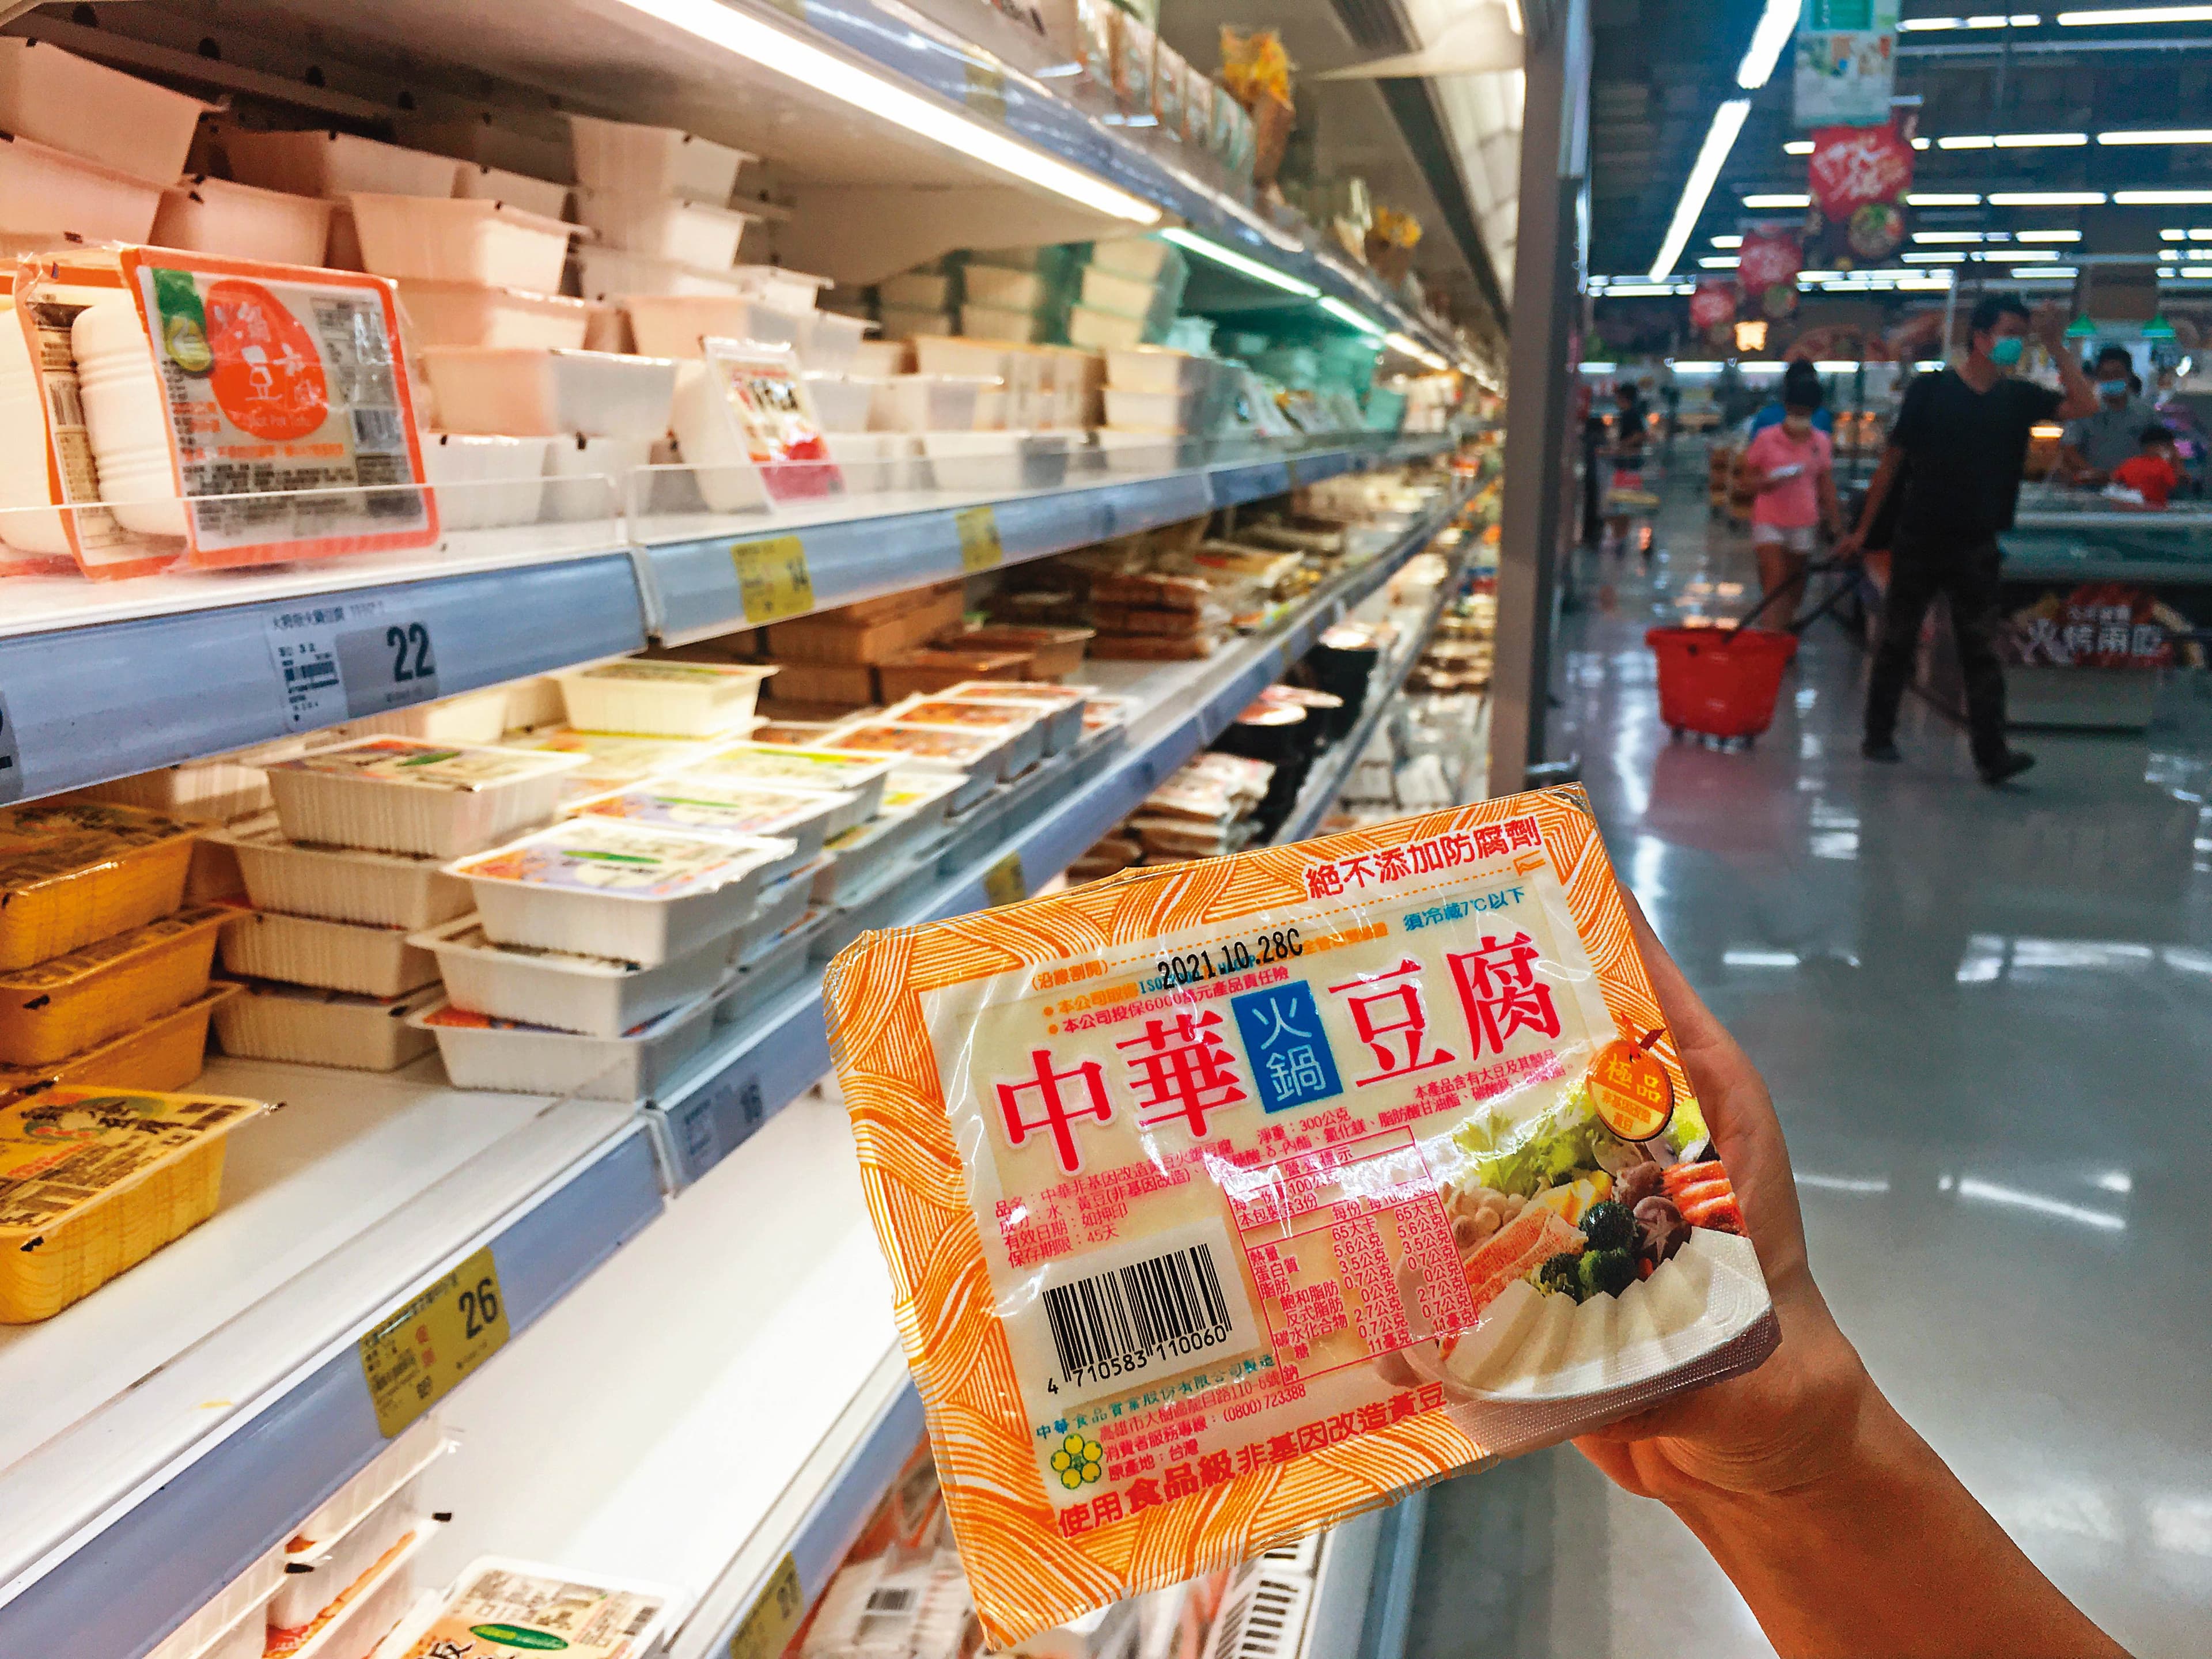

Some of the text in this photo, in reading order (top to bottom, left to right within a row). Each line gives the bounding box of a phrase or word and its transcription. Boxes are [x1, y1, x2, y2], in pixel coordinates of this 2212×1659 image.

[387, 622, 436, 683] 22
[1305, 816, 1543, 899] 絕不添加防腐劑
[1157, 927, 1303, 990] 2021.10.28C
[996, 931, 1562, 1172] 中華 火鍋 豆腐
[1604, 1053, 1661, 1103] 極品
[1004, 1202, 1128, 1250] 有效日期：如押印
[1008, 1225, 1119, 1268] 保存期限：45天
[1255, 1213, 1446, 1282] 蛋白質 5.6公克 5.6公克
[1332, 1217, 1377, 1241] 65大卡
[1396, 1198, 1439, 1222] 65大卡
[1260, 1230, 1451, 1300] 脂肪 3.5公克 3.5公克
[1280, 1247, 1456, 1310] 飽和脂肪 0.7公克 0.7公克
[1286, 1262, 1461, 1326] 反式脂肪 0公克 0公克
[459, 1278, 498, 1339] 26
[1274, 1277, 1467, 1348] 碳水化合物 2.7公克 2.7公克
[1358, 1313, 1408, 1339] 0.7公克
[1422, 1293, 1471, 1319] 0.7公克
[1368, 1330, 1412, 1354] 11毫克
[1433, 1311, 1475, 1333] 11毫克
[1047, 1327, 1228, 1394] 4 710583 110060
[1058, 1381, 1447, 1537] 使用食品級非基因改造黃豆
